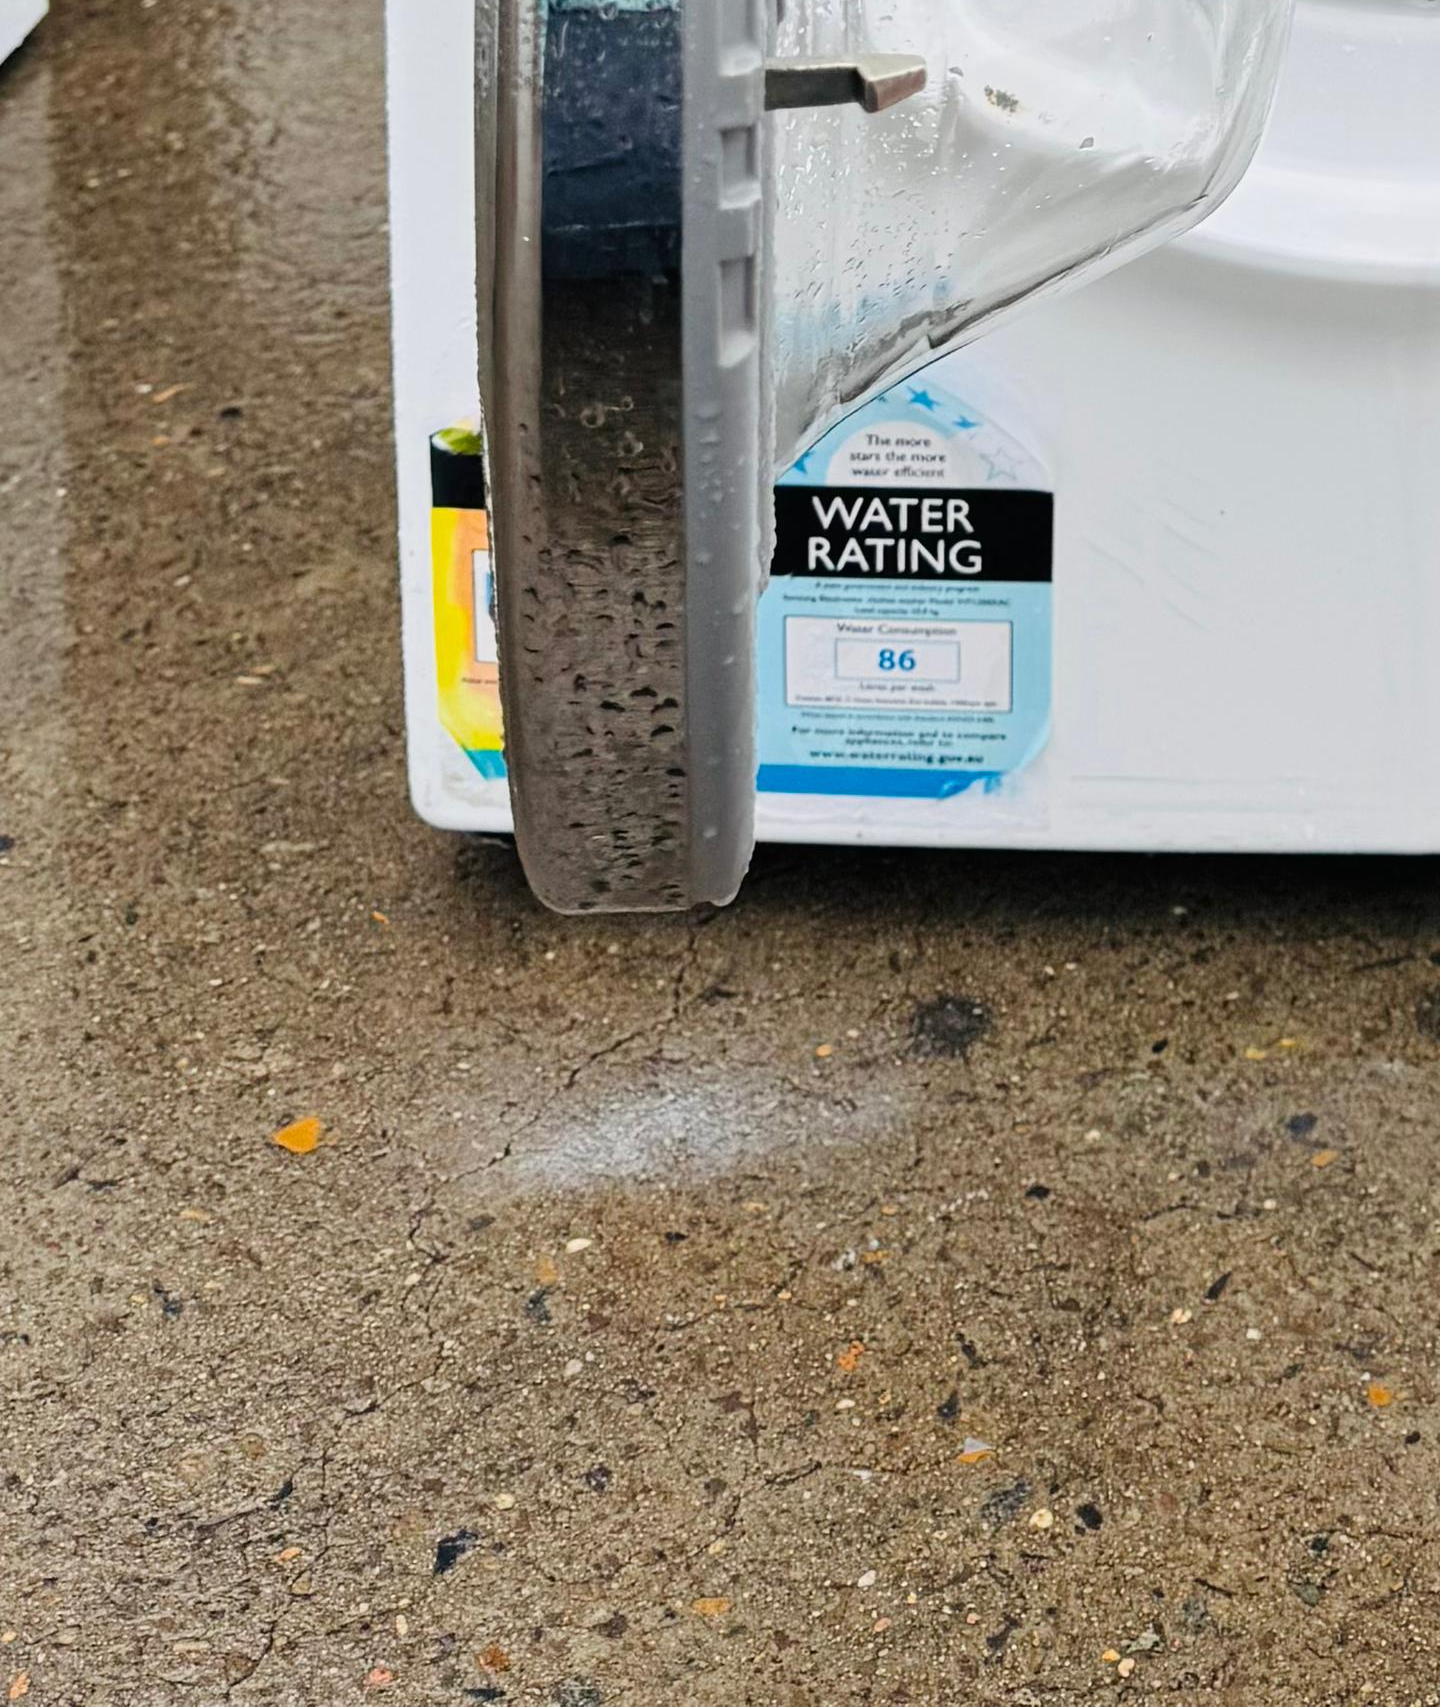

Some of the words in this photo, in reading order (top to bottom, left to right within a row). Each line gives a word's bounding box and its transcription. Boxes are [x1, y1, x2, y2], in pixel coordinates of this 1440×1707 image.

[867, 434, 891, 446] The
[895, 437, 930, 448] more
[850, 453, 880, 461] stars
[885, 451, 907, 461] the
[911, 453, 946, 462] more
[852, 468, 888, 477] water
[894, 467, 944, 478] efficient
[812, 495, 974, 533] WATER
[808, 536, 982, 574] RATING
[837, 623, 873, 633] Water
[877, 624, 957, 637] Consumption
[878, 649, 916, 671] 86
